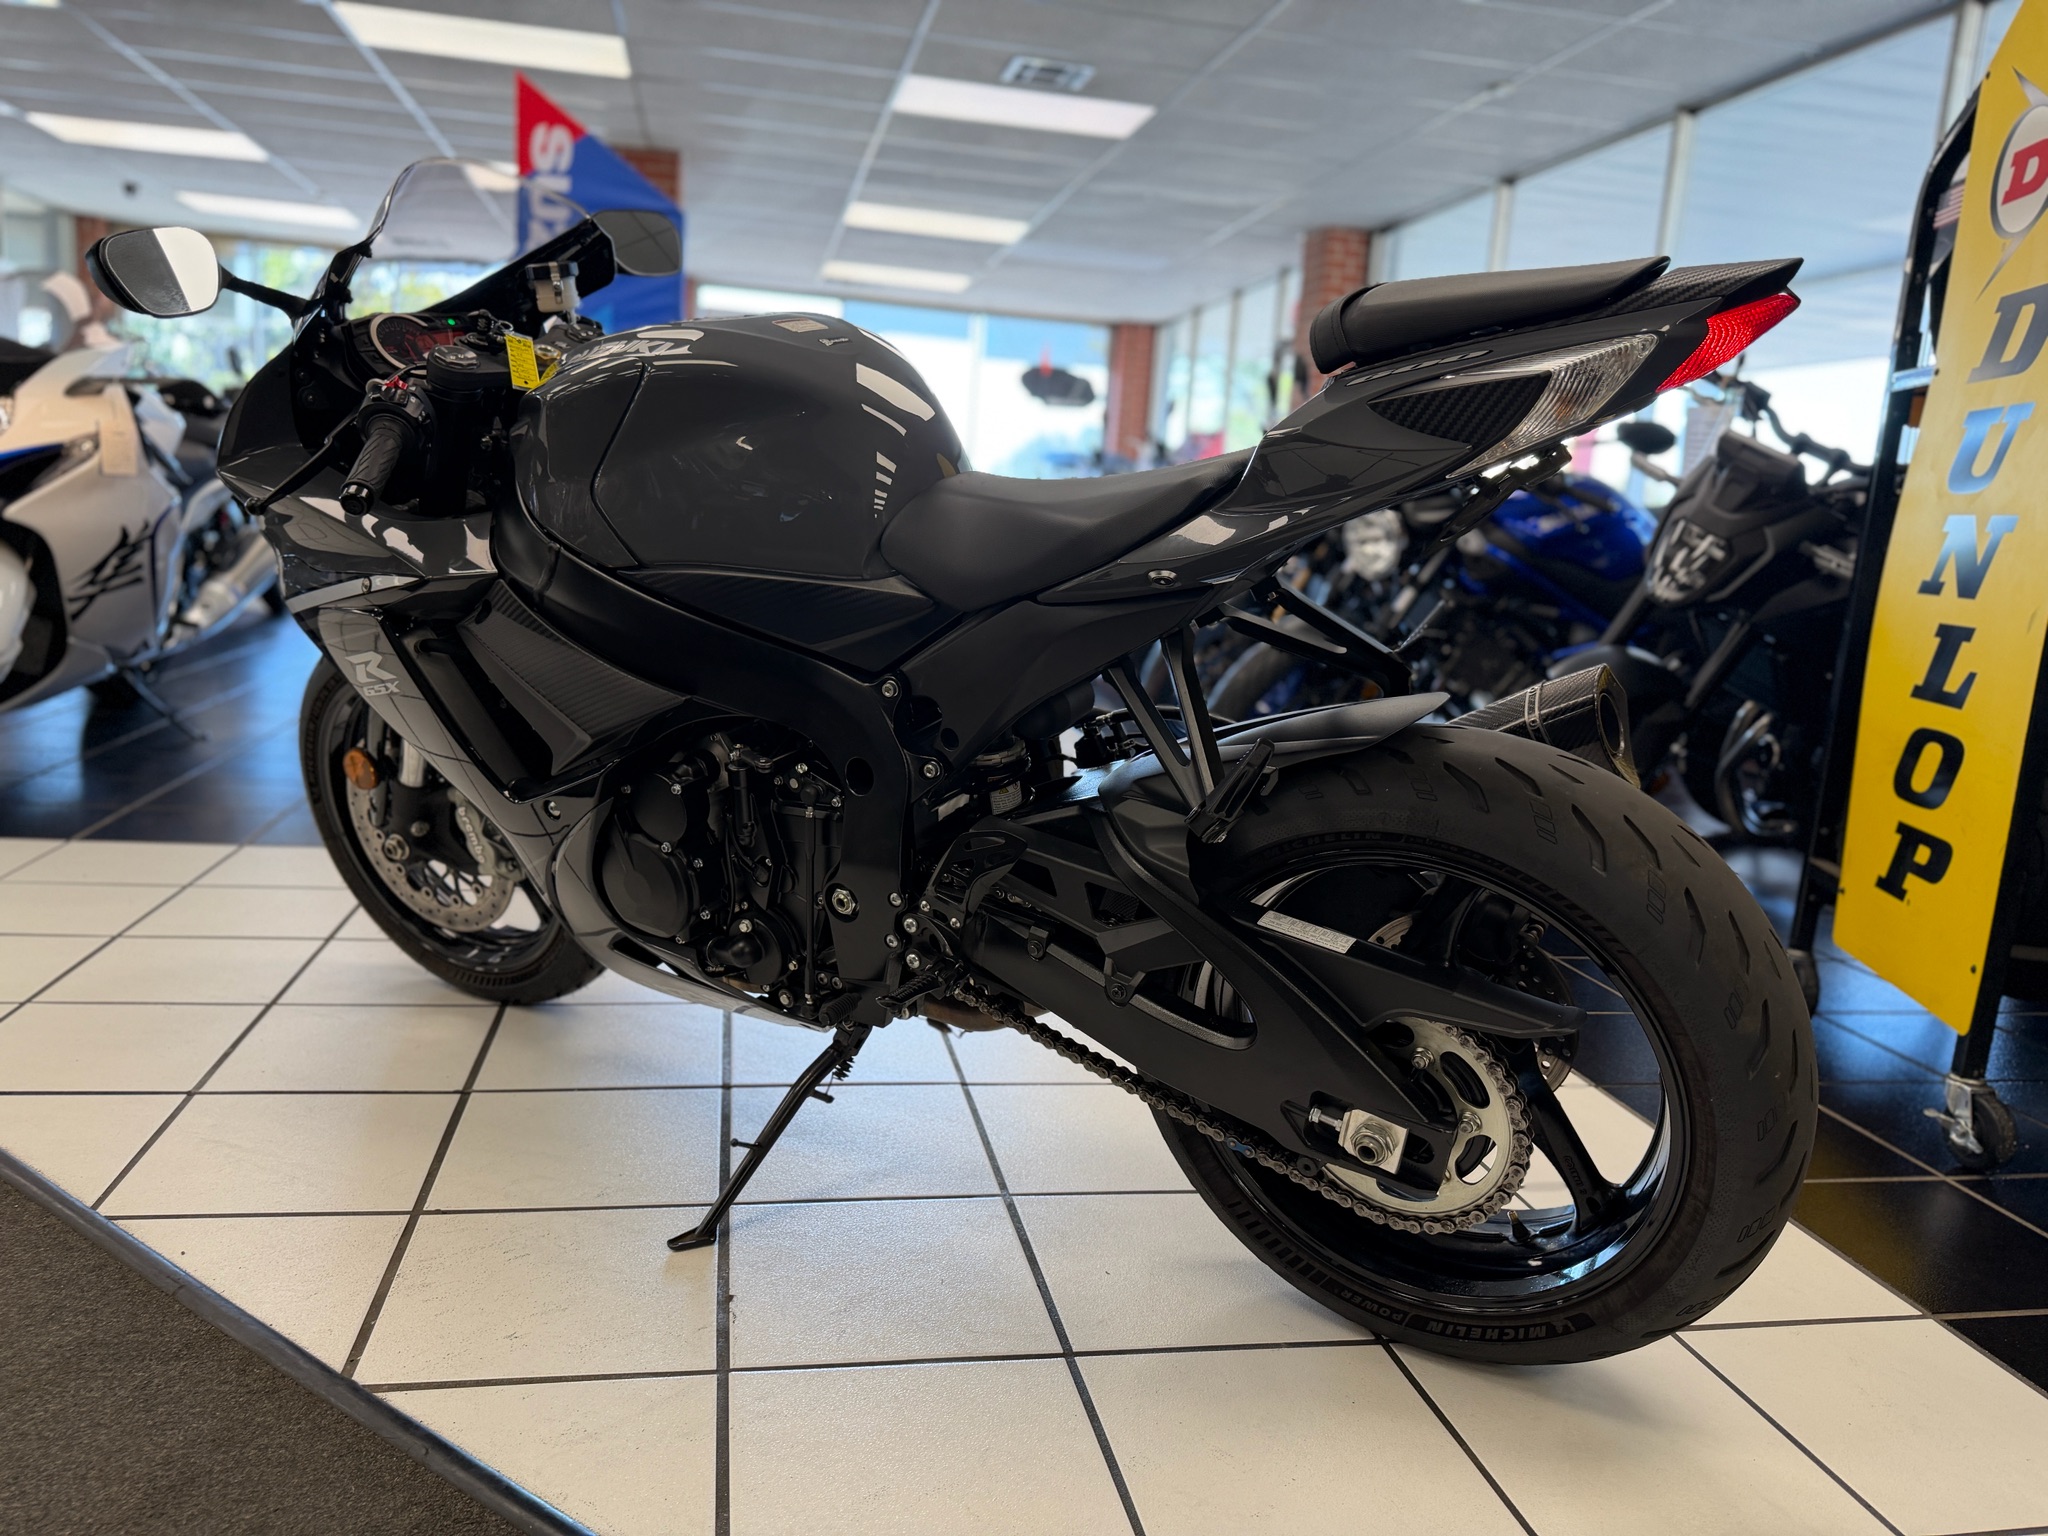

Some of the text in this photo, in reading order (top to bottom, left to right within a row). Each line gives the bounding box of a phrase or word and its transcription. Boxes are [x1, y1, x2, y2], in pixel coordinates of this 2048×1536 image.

[2001, 138, 2048, 206] D
[1873, 282, 2048, 902] DUNLOP
[344, 650, 398, 683] R
[362, 680, 401, 697] GSX
[458, 806, 485, 864] brembo
[1340, 1289, 1404, 1322] POWER
[1426, 1319, 1548, 1341] MICHELIN
